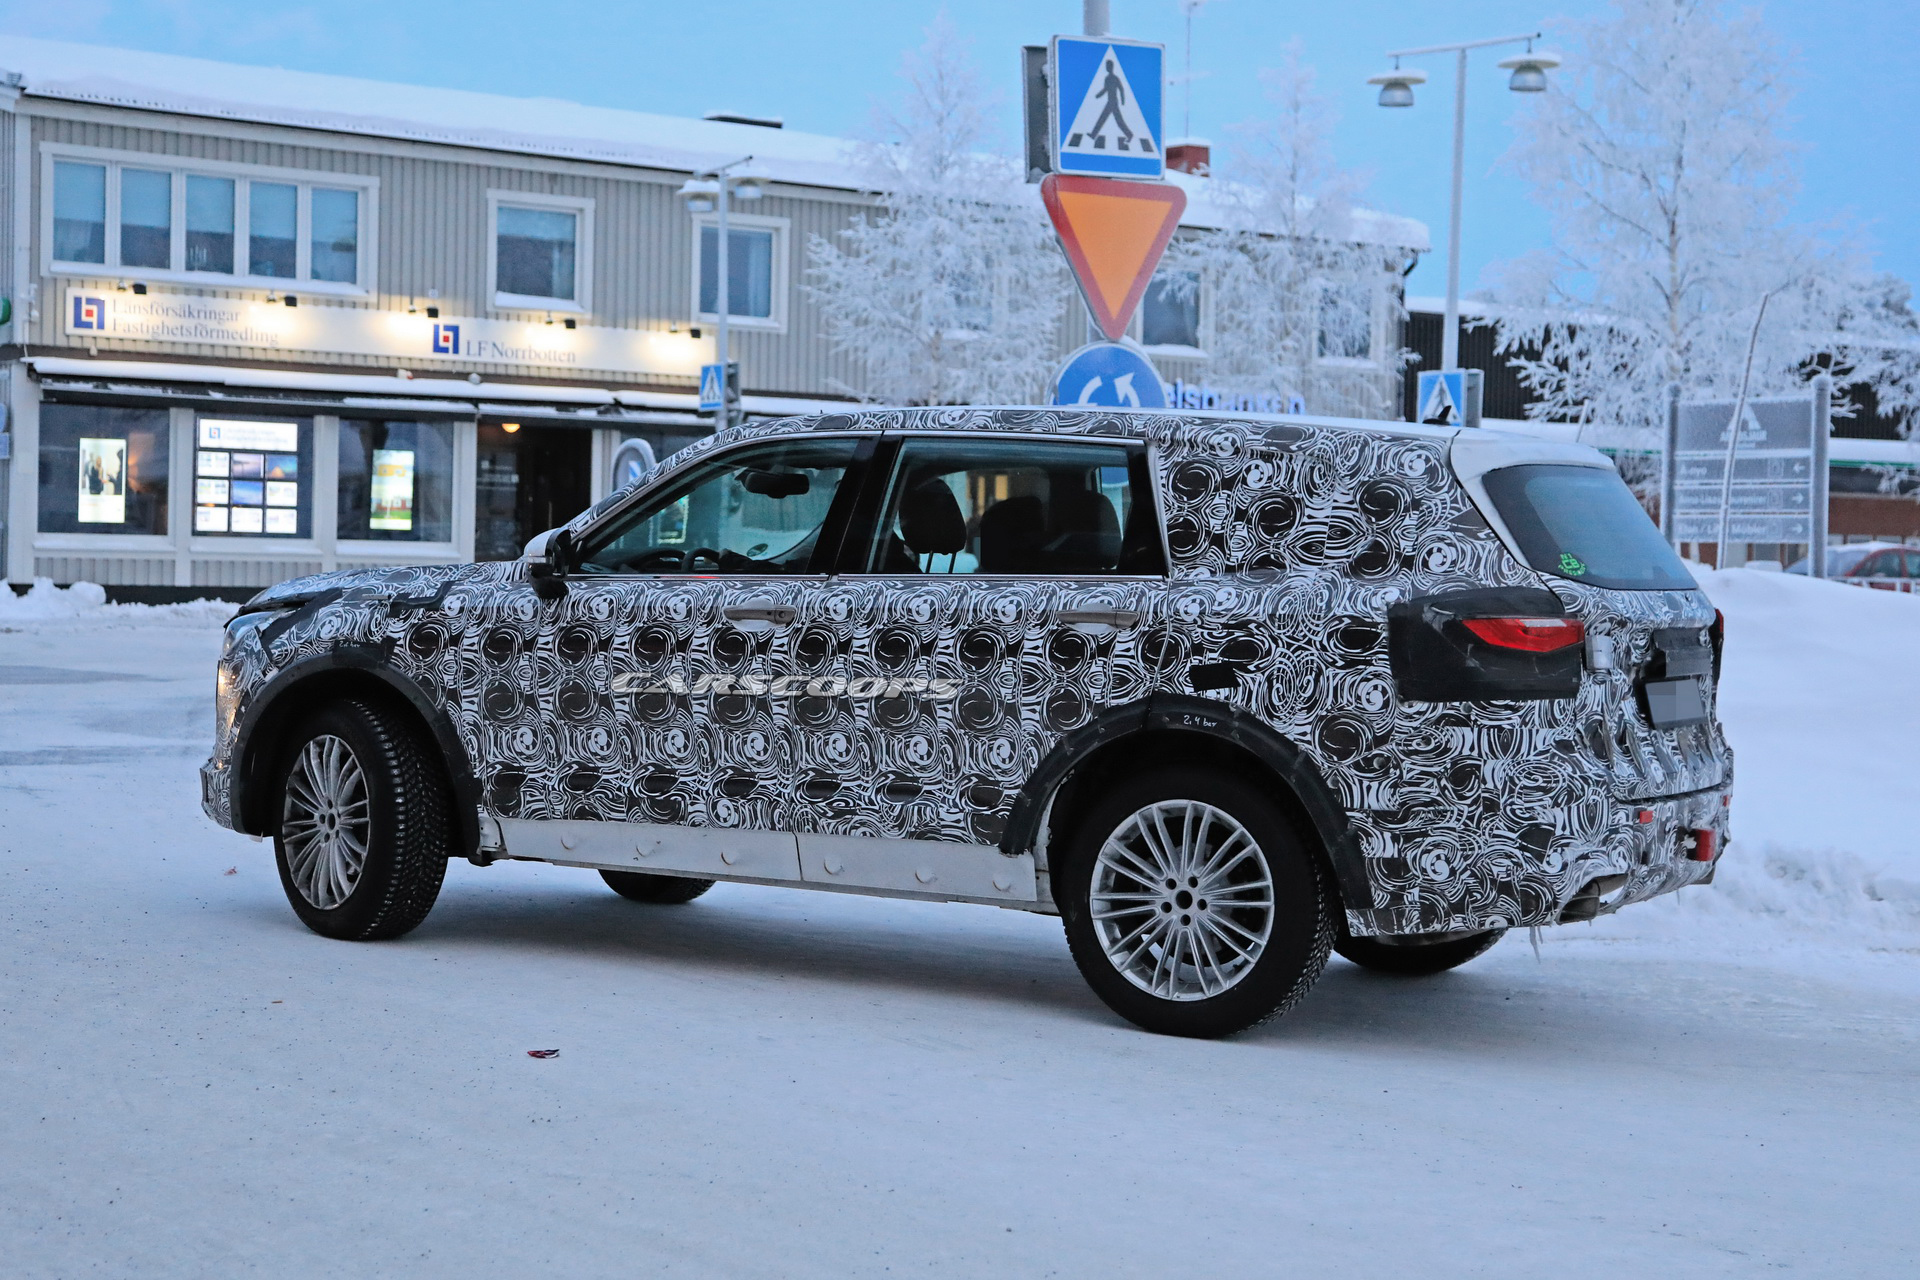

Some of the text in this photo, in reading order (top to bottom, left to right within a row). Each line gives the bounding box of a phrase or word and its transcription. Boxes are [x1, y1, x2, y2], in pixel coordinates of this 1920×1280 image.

[112, 298, 240, 323] Länsförsäkringar
[112, 318, 279, 347] Fastighetsförmedling
[466, 339, 576, 364] LF Norrbotten
[1163, 377, 1306, 415] elsbanken
